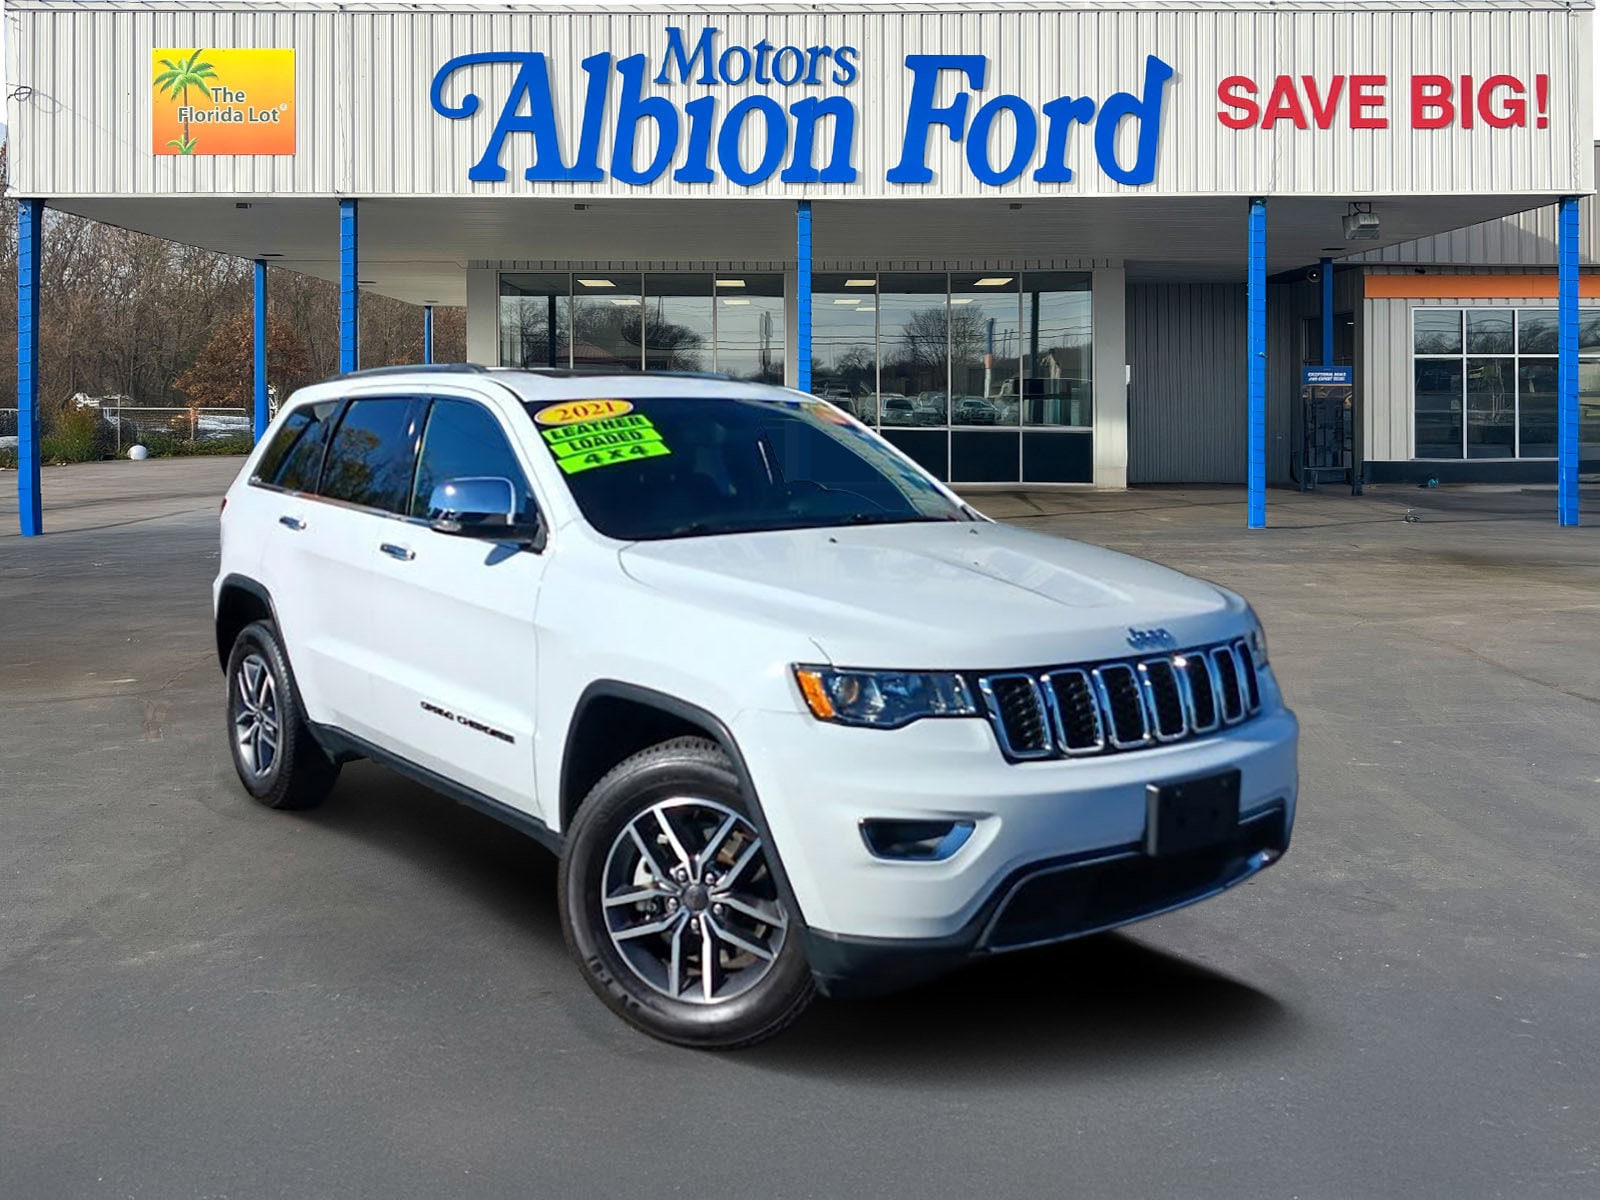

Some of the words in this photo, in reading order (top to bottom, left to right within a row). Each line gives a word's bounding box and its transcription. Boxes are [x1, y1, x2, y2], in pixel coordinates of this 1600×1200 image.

[653, 27, 860, 86] Motors
[211, 86, 246, 103] The
[1217, 74, 1388, 130] SAVE
[1410, 74, 1548, 130] BIG!
[178, 106, 243, 122] Florida
[248, 107, 280, 122] Lot
[430, 51, 858, 186] Albion
[886, 55, 1174, 187] Ford
[558, 401, 616, 421] 2021
[550, 416, 643, 440] LEATHER
[568, 430, 643, 451] LOADED
